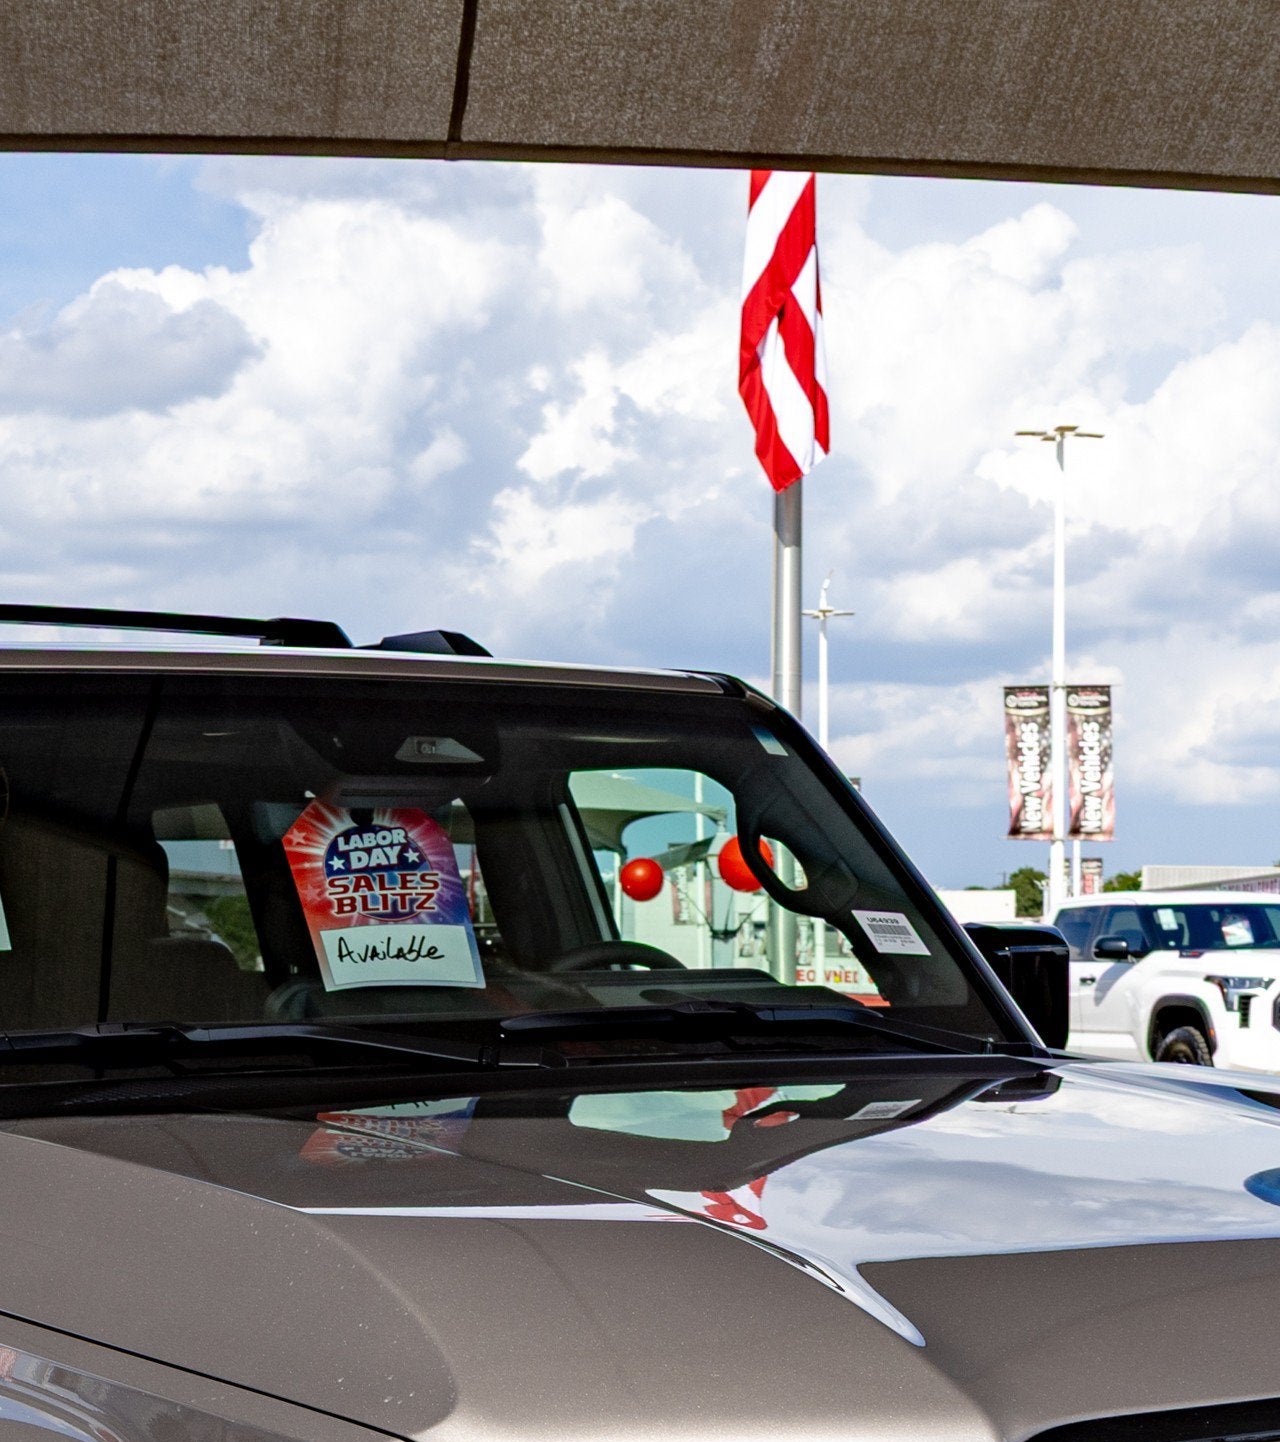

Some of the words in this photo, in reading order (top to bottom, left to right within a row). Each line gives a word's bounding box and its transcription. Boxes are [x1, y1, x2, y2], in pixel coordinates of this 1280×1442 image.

[1017, 722, 1041, 795] Vehicles
[1078, 721, 1102, 794] Vehicles
[1020, 795, 1043, 833] New
[1080, 795, 1103, 833] New
[337, 829, 407, 851] LABOR
[349, 847, 401, 869] DAY
[328, 872, 439, 895] SALES
[334, 892, 435, 915] BLITZ
